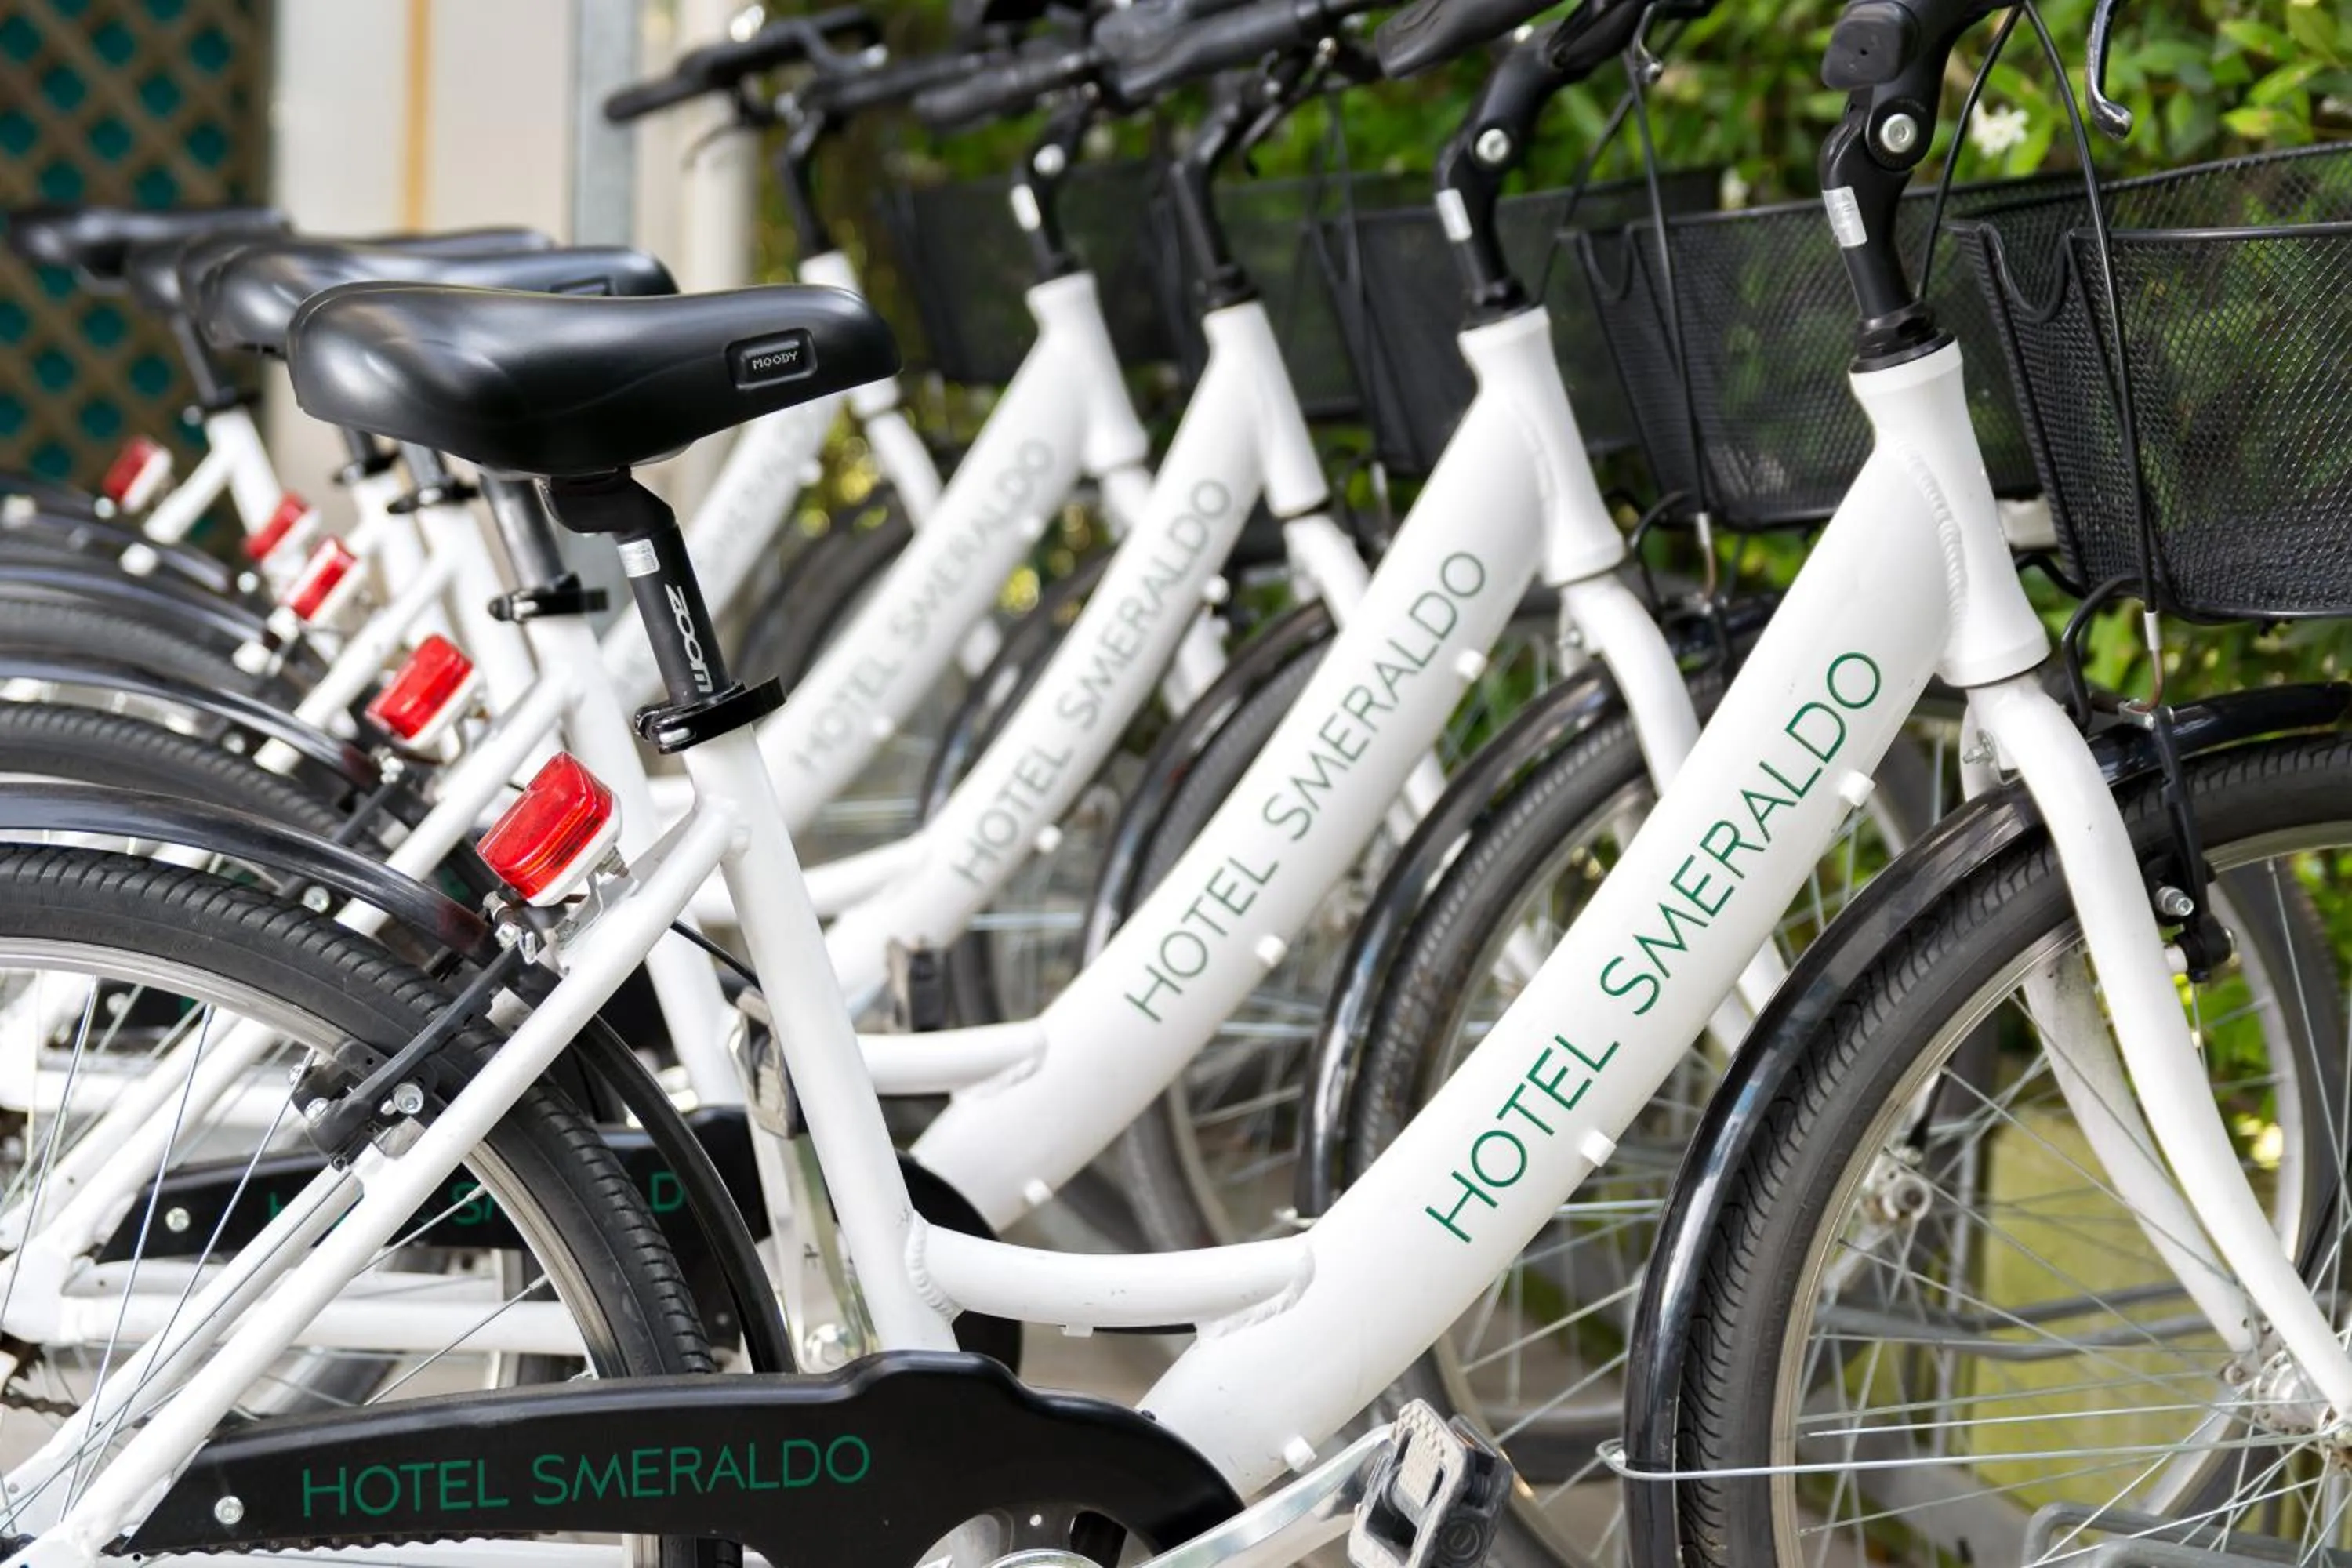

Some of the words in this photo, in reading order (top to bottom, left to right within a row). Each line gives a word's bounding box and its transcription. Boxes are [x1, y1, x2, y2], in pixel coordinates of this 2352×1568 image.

[752, 350, 798, 370] MOODY
[951, 746, 1074, 887] HOTEL
[1055, 479, 1232, 731] SMERALDO
[1124, 856, 1279, 1022] HOTEL
[1262, 551, 1486, 842] SMERALDO
[1425, 1034, 1621, 1243] HOTEL
[1599, 652, 1882, 1016] SMERALDO
[302, 1458, 510, 1518] HOTEL
[532, 1436, 871, 1506] SMERALDO
